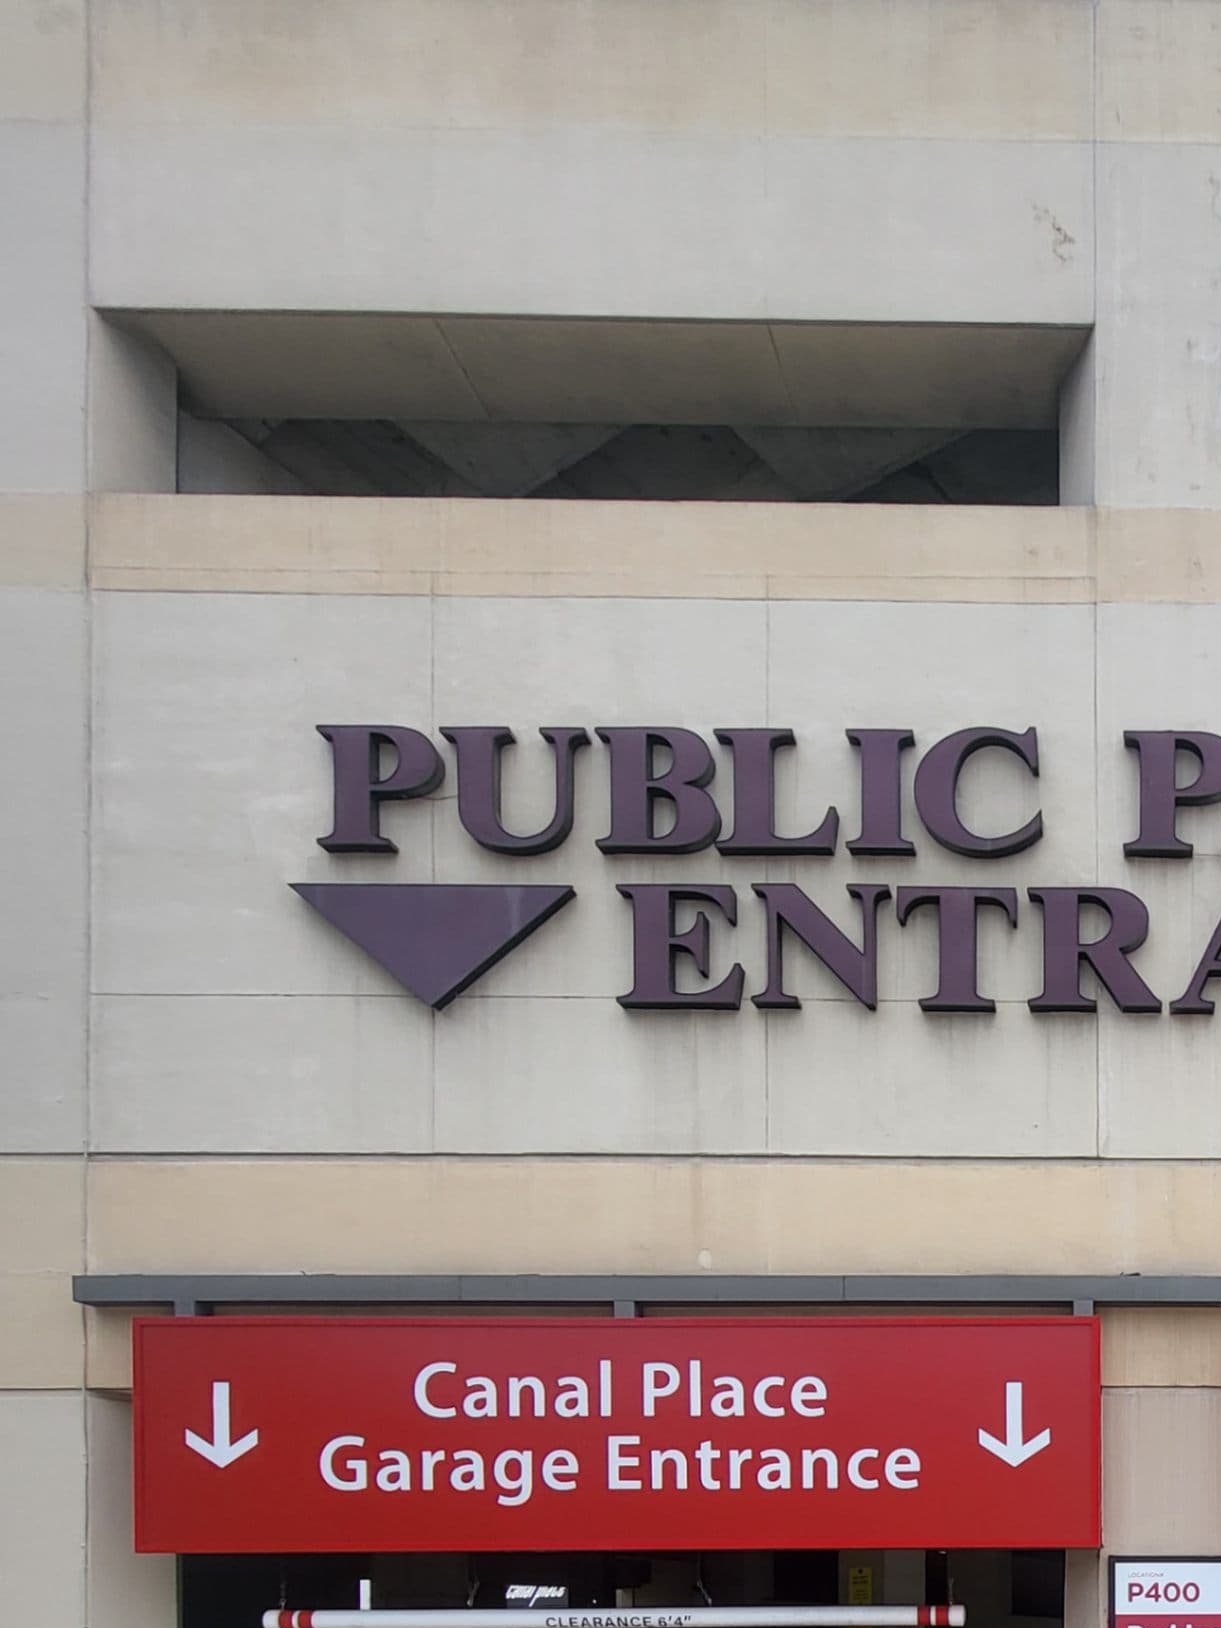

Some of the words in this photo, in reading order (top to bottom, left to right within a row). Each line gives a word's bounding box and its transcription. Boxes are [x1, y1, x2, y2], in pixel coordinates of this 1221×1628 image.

[316, 725, 1043, 859] PUBLIC
[413, 1360, 612, 1418] Canal
[642, 1360, 828, 1418] Place
[319, 1435, 580, 1506] Garage
[606, 1435, 921, 1491] Entrance
[545, 1616, 652, 1628] CLEARANCE
[657, 1615, 692, 1627] 6'4"
[1127, 1582, 1201, 1603] P400
